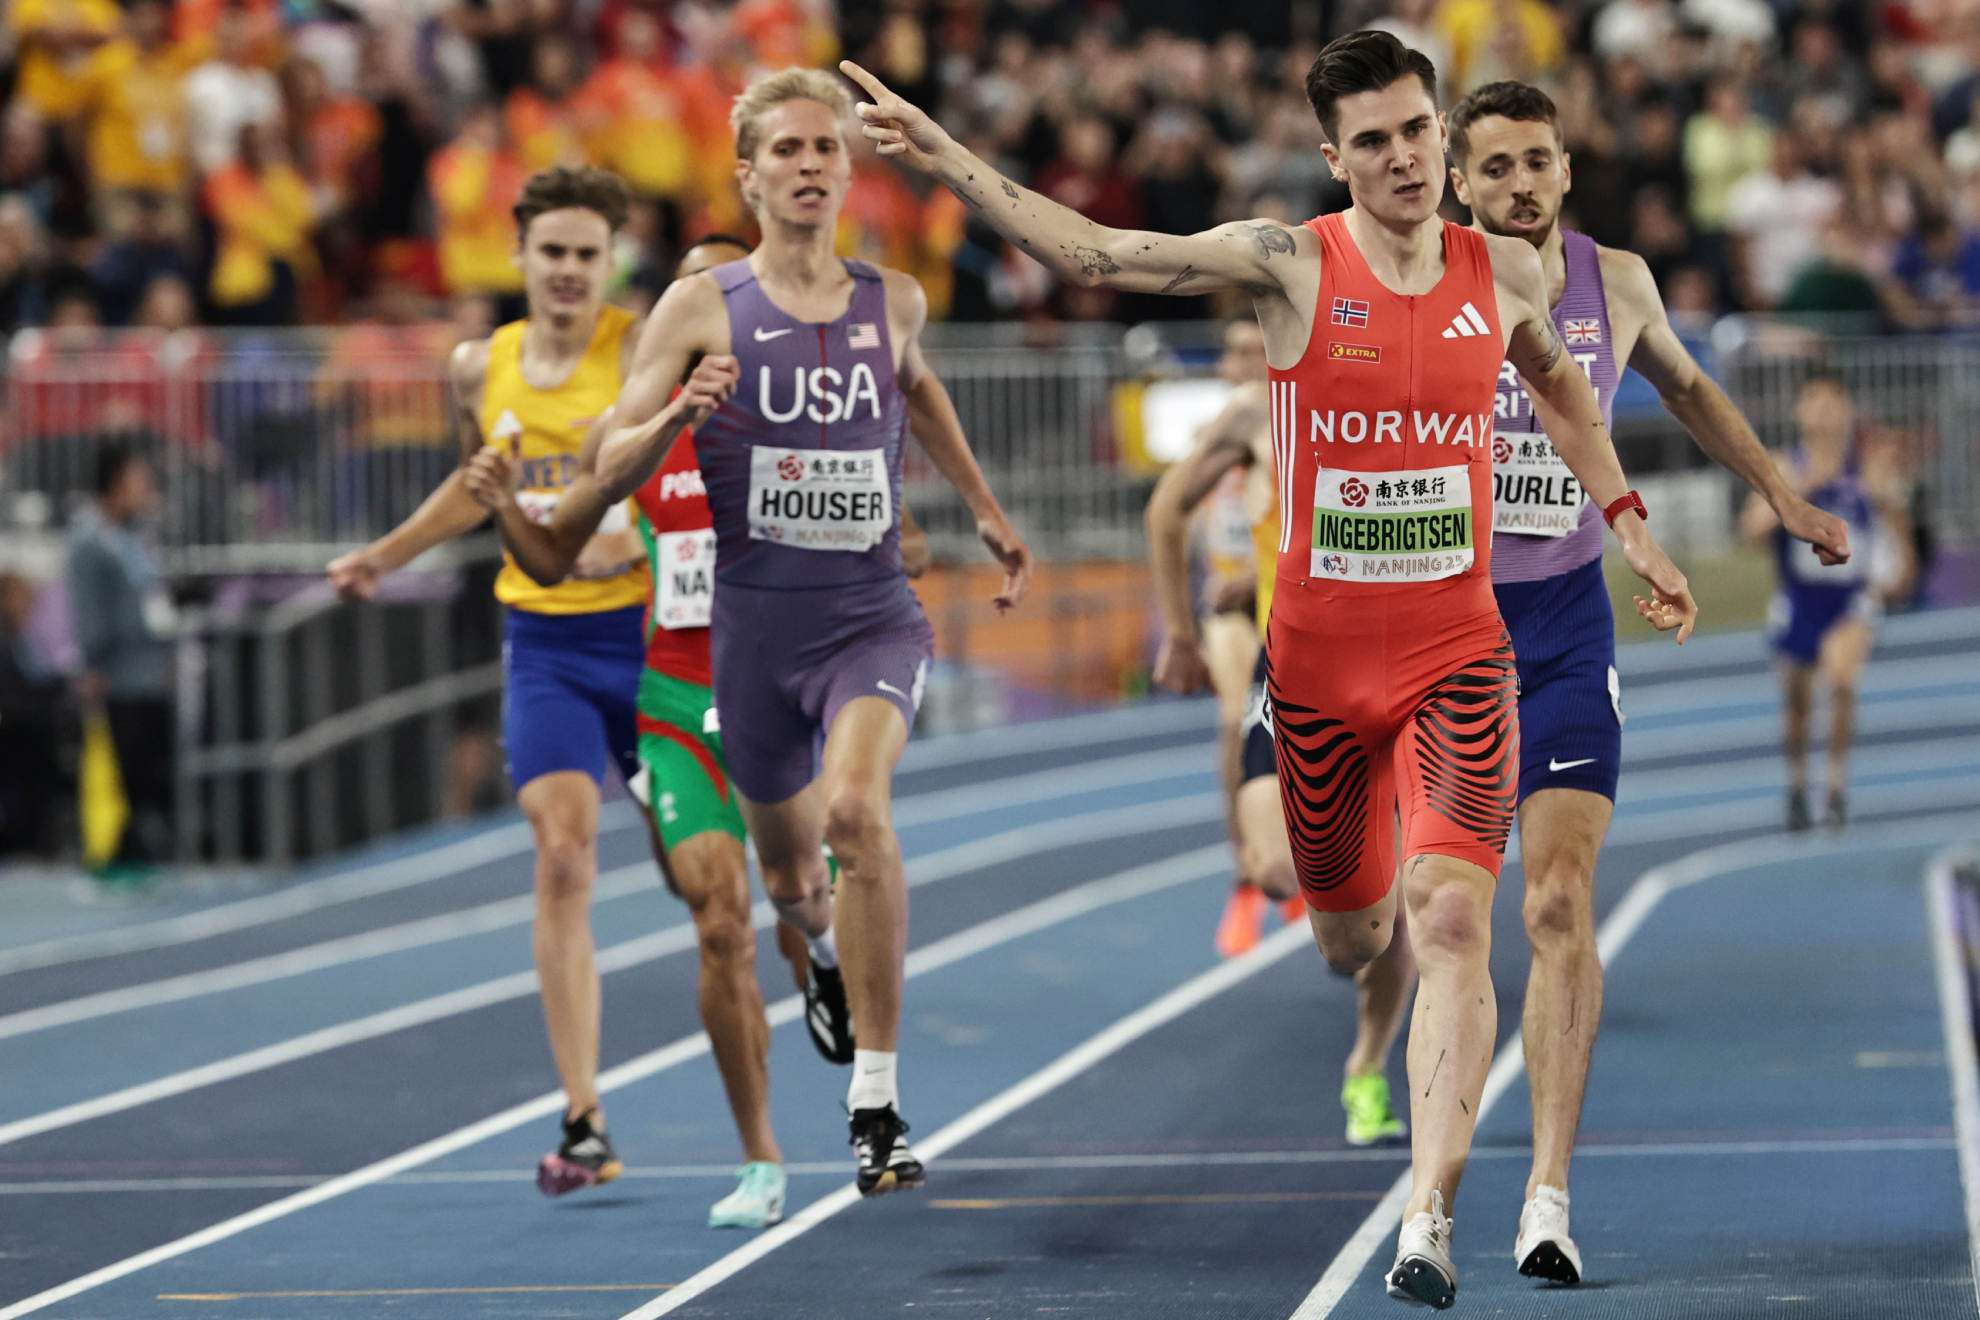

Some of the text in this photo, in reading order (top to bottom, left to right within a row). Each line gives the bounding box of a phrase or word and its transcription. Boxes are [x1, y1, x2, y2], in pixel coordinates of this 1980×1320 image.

[1345, 348, 1377, 359] EXTRA
[759, 362, 881, 424] USA
[1310, 409, 1491, 448] NORWAY
[1375, 476, 1446, 499] 南京银行
[761, 488, 883, 521] HOUSER
[1413, 496, 1446, 505] NANJING
[1319, 512, 1466, 551] INGEBRIGTSEN
[1497, 512, 1570, 530] NANJING
[1362, 555, 1465, 577] NANJING 25
